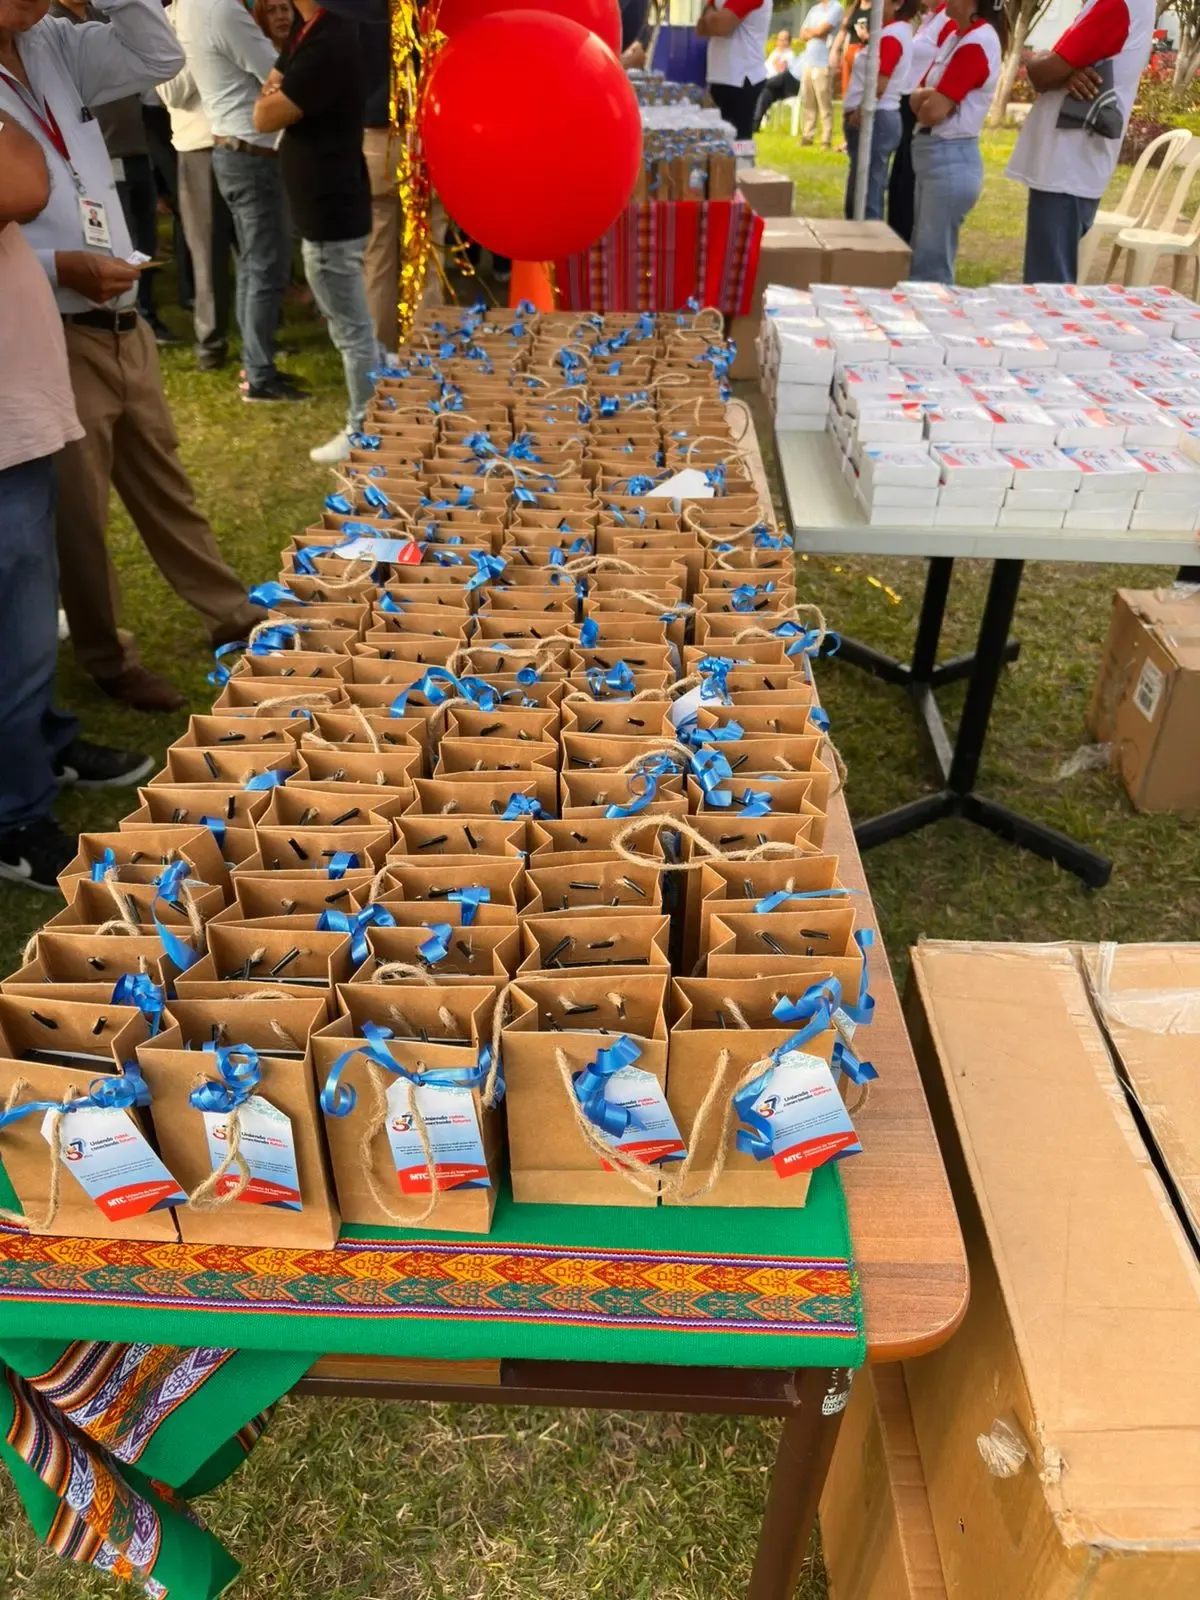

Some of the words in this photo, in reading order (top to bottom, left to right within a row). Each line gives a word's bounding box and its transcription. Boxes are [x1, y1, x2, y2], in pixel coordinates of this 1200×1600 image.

[784, 1090, 808, 1101] Uniendo
[783, 1152, 803, 1164] MTC
[409, 1172, 430, 1180] MTC
[107, 1196, 127, 1207] MTC
